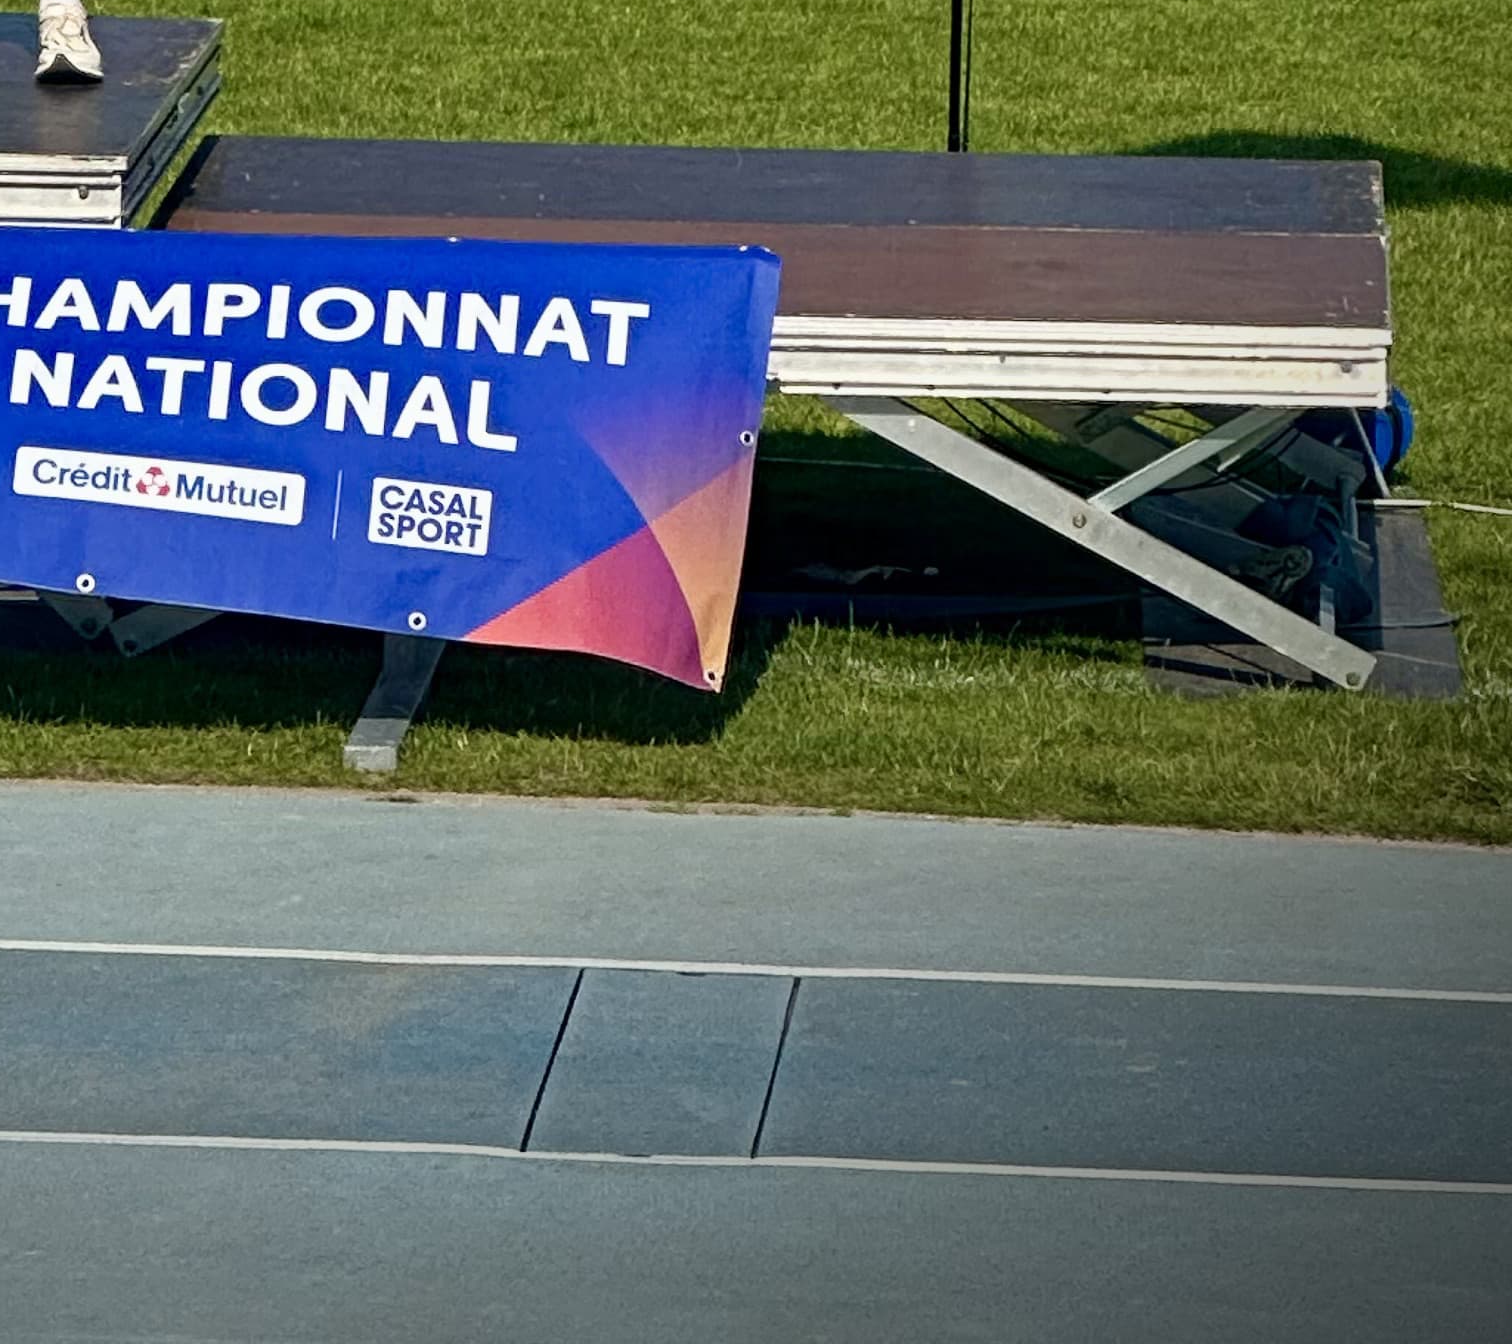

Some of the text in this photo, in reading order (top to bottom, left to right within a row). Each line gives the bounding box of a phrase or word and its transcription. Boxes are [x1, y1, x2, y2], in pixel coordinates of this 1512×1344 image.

[9, 348, 517, 452] NATIONAL
[31, 458, 288, 512] Crédit Mutuel
[378, 483, 484, 525] CASAL
[376, 511, 482, 549] SPORT
